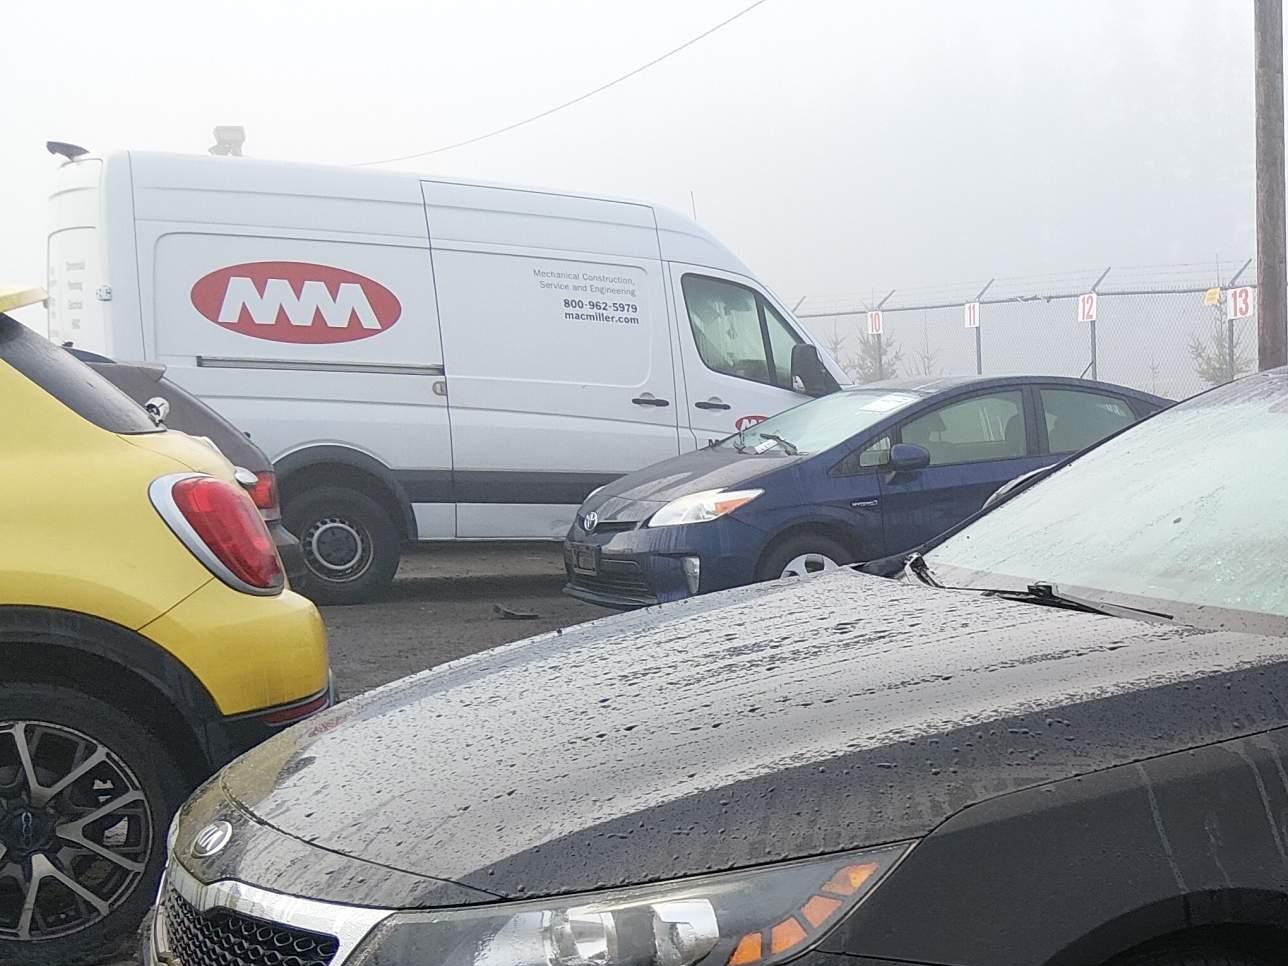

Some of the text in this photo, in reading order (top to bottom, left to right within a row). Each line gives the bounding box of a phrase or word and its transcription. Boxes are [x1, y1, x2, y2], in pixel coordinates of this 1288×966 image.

[533, 269, 636, 286] Mechanical Construction,
[539, 281, 637, 298] Service and Engineering
[563, 298, 638, 313] 800-962-5979
[1082, 295, 1094, 321] 12
[1231, 288, 1249, 317] 13
[564, 312, 639, 324] macmiller.com
[870, 312, 881, 333] 10
[968, 303, 976, 327] 11
